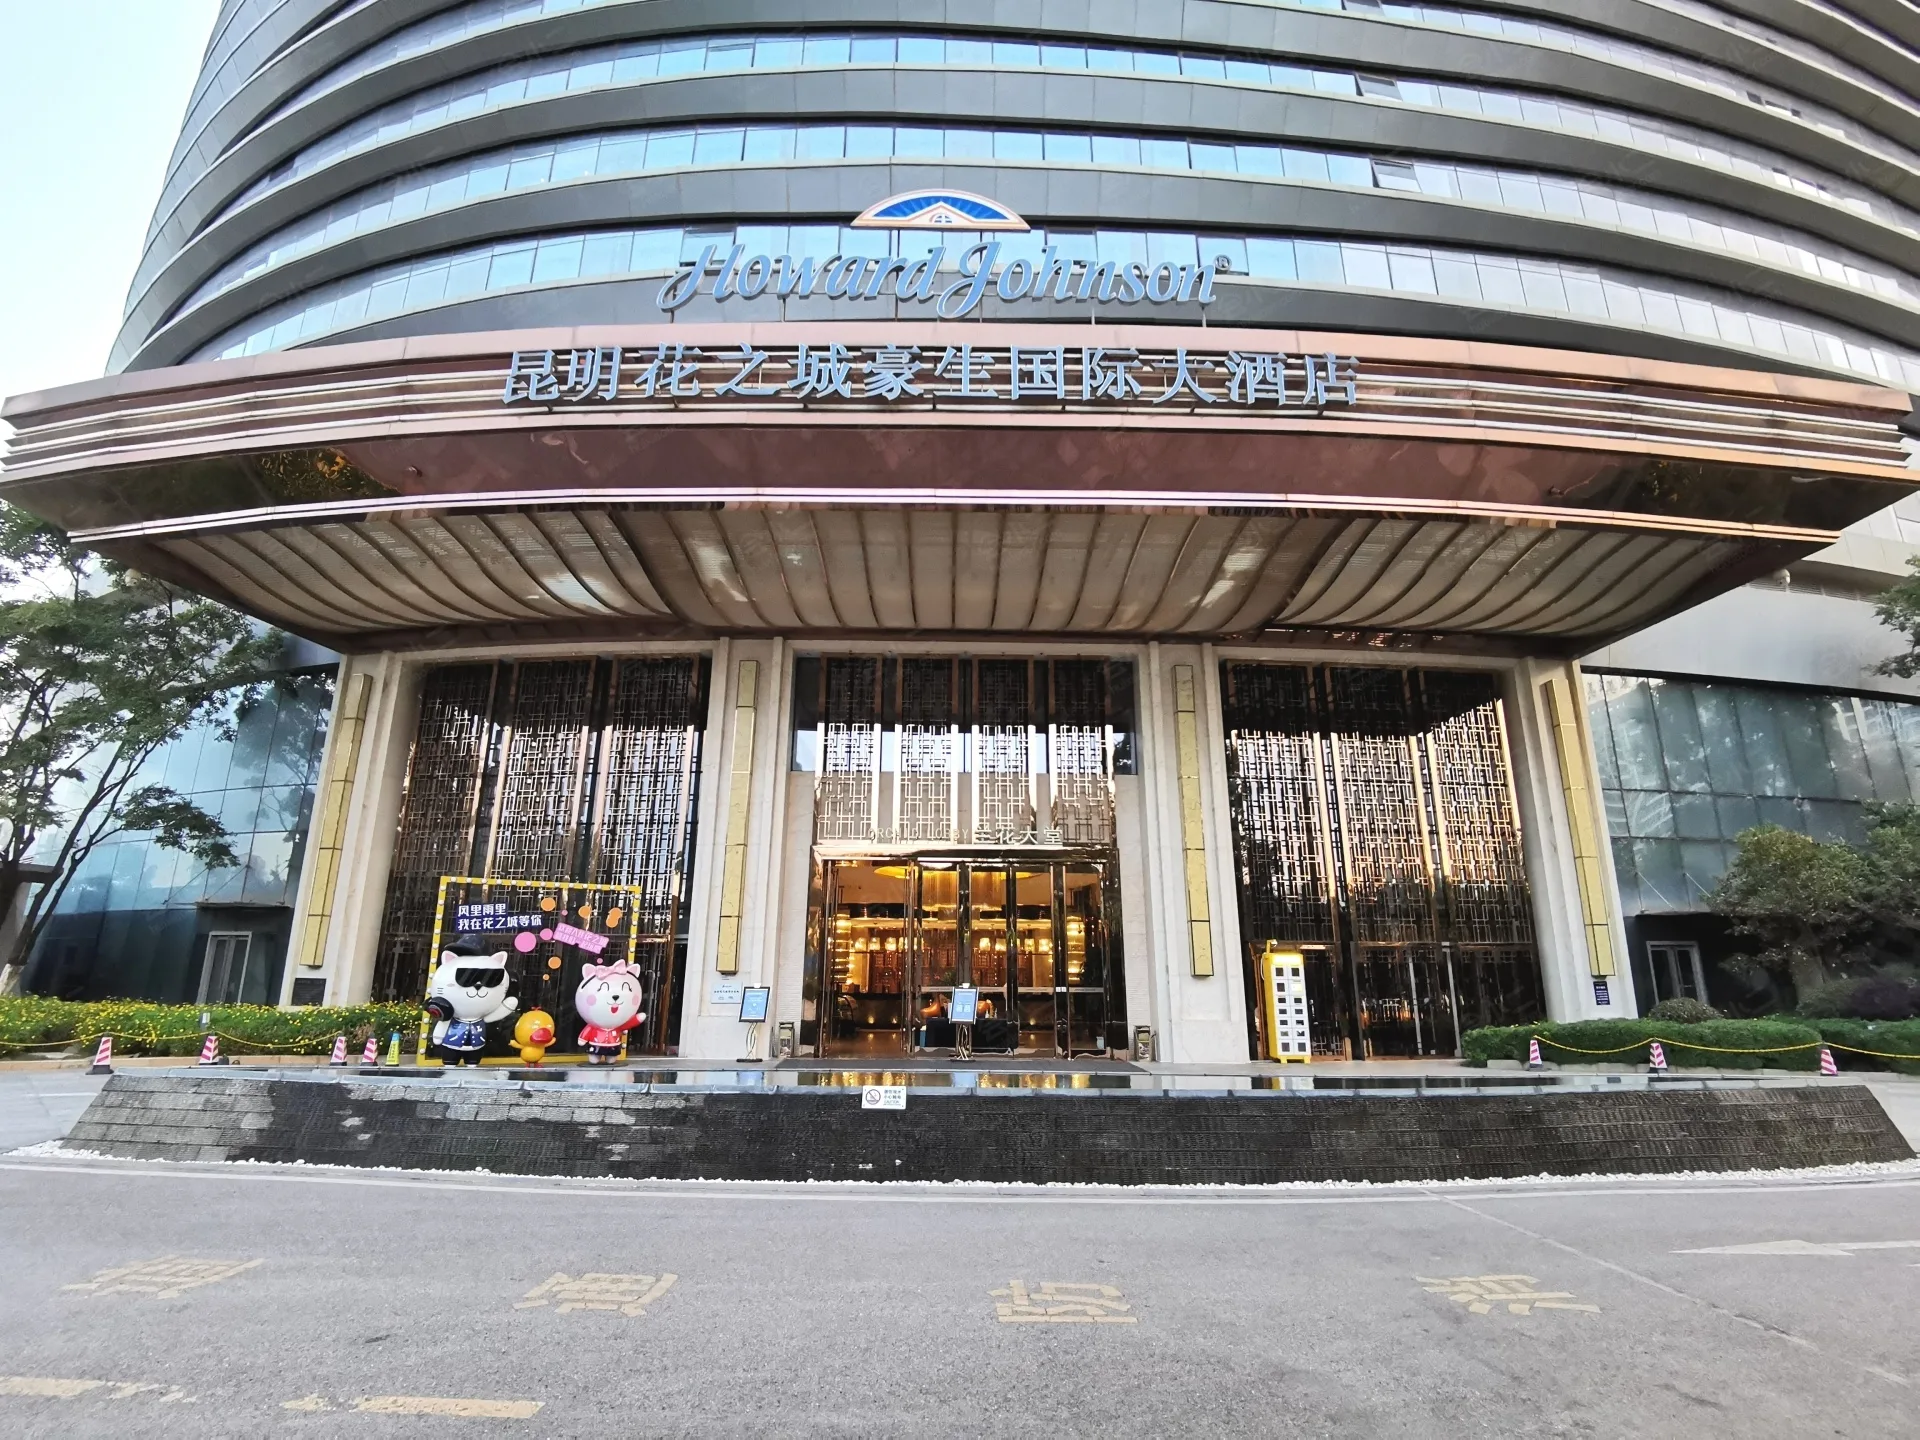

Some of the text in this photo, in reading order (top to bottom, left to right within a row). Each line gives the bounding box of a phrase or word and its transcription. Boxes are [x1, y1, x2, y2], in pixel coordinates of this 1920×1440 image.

[656, 241, 1217, 320] Howard Johnson
[502, 341, 1361, 406] 昆明花之城豪生国际大酒店
[974, 825, 1064, 845] 兰花大堂
[457, 903, 507, 917] 风里雨里
[457, 914, 542, 931] 我在花之城等你
